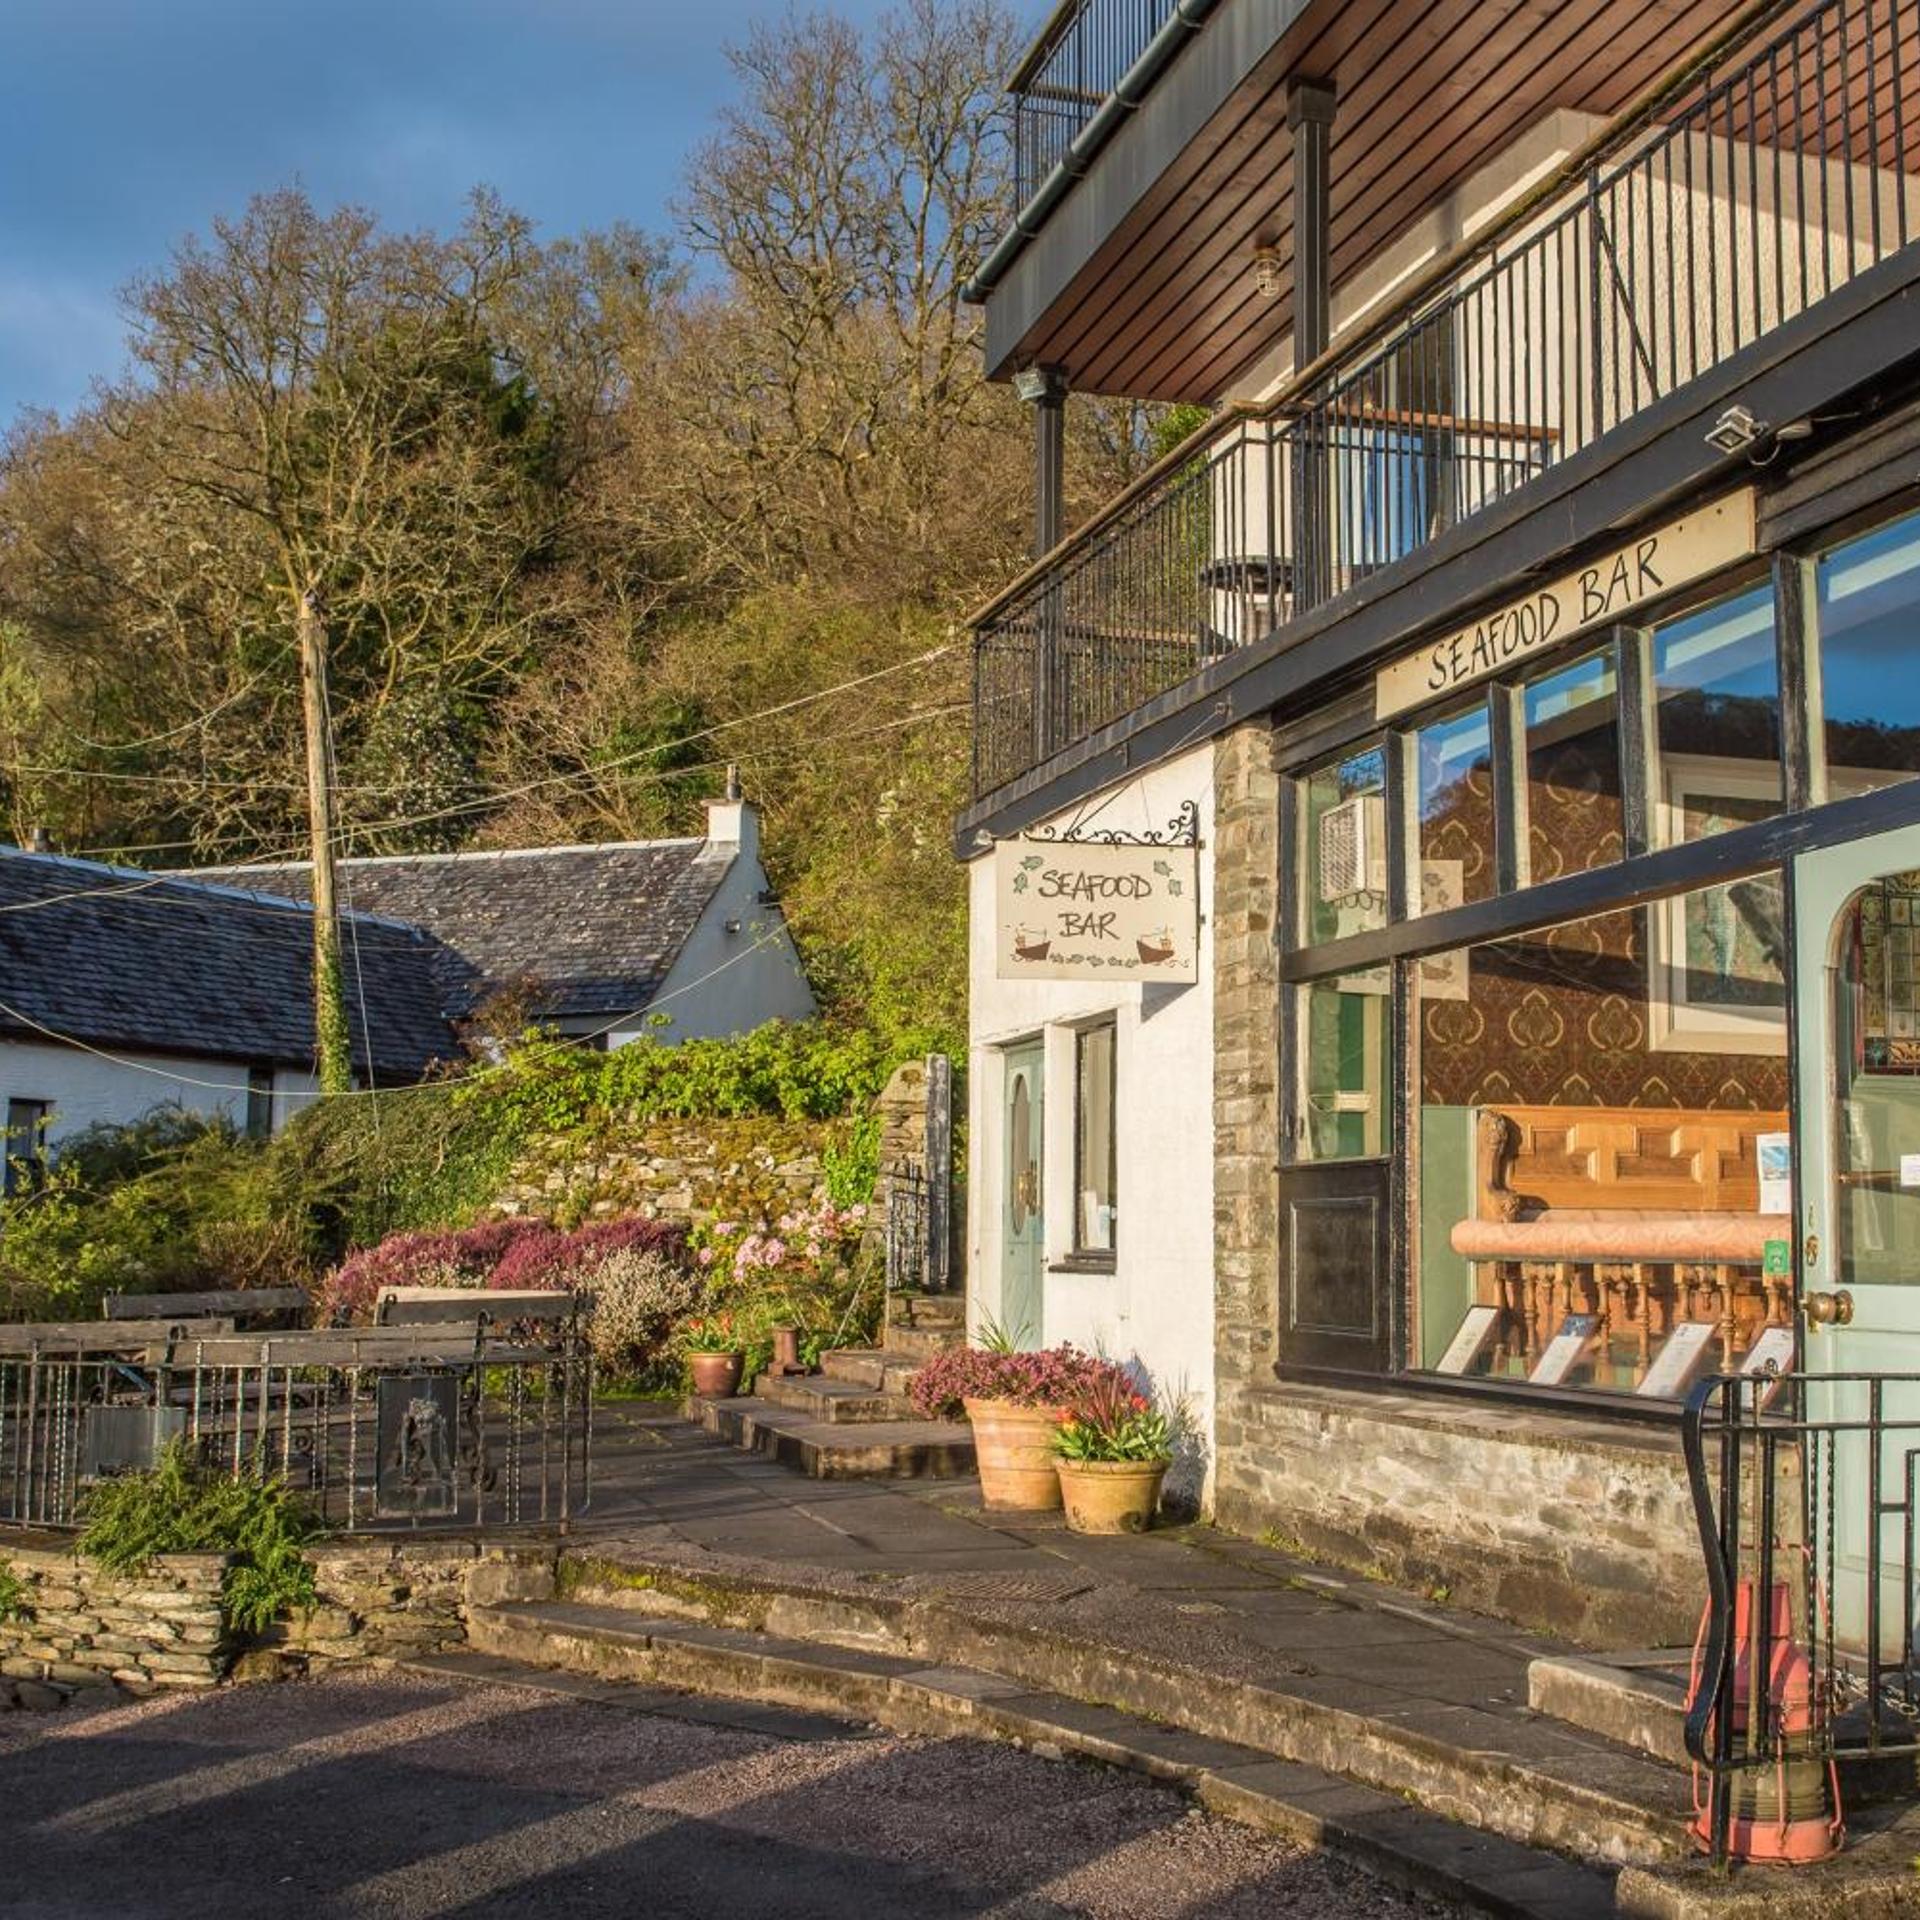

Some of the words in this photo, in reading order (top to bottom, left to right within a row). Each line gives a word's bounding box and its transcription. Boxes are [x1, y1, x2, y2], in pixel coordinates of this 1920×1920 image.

[1428, 592, 1560, 690] SEAFOOD
[1578, 537, 1663, 624] BAR
[1038, 870, 1152, 902] SEAFOOD
[1058, 912, 1120, 940] BAR
